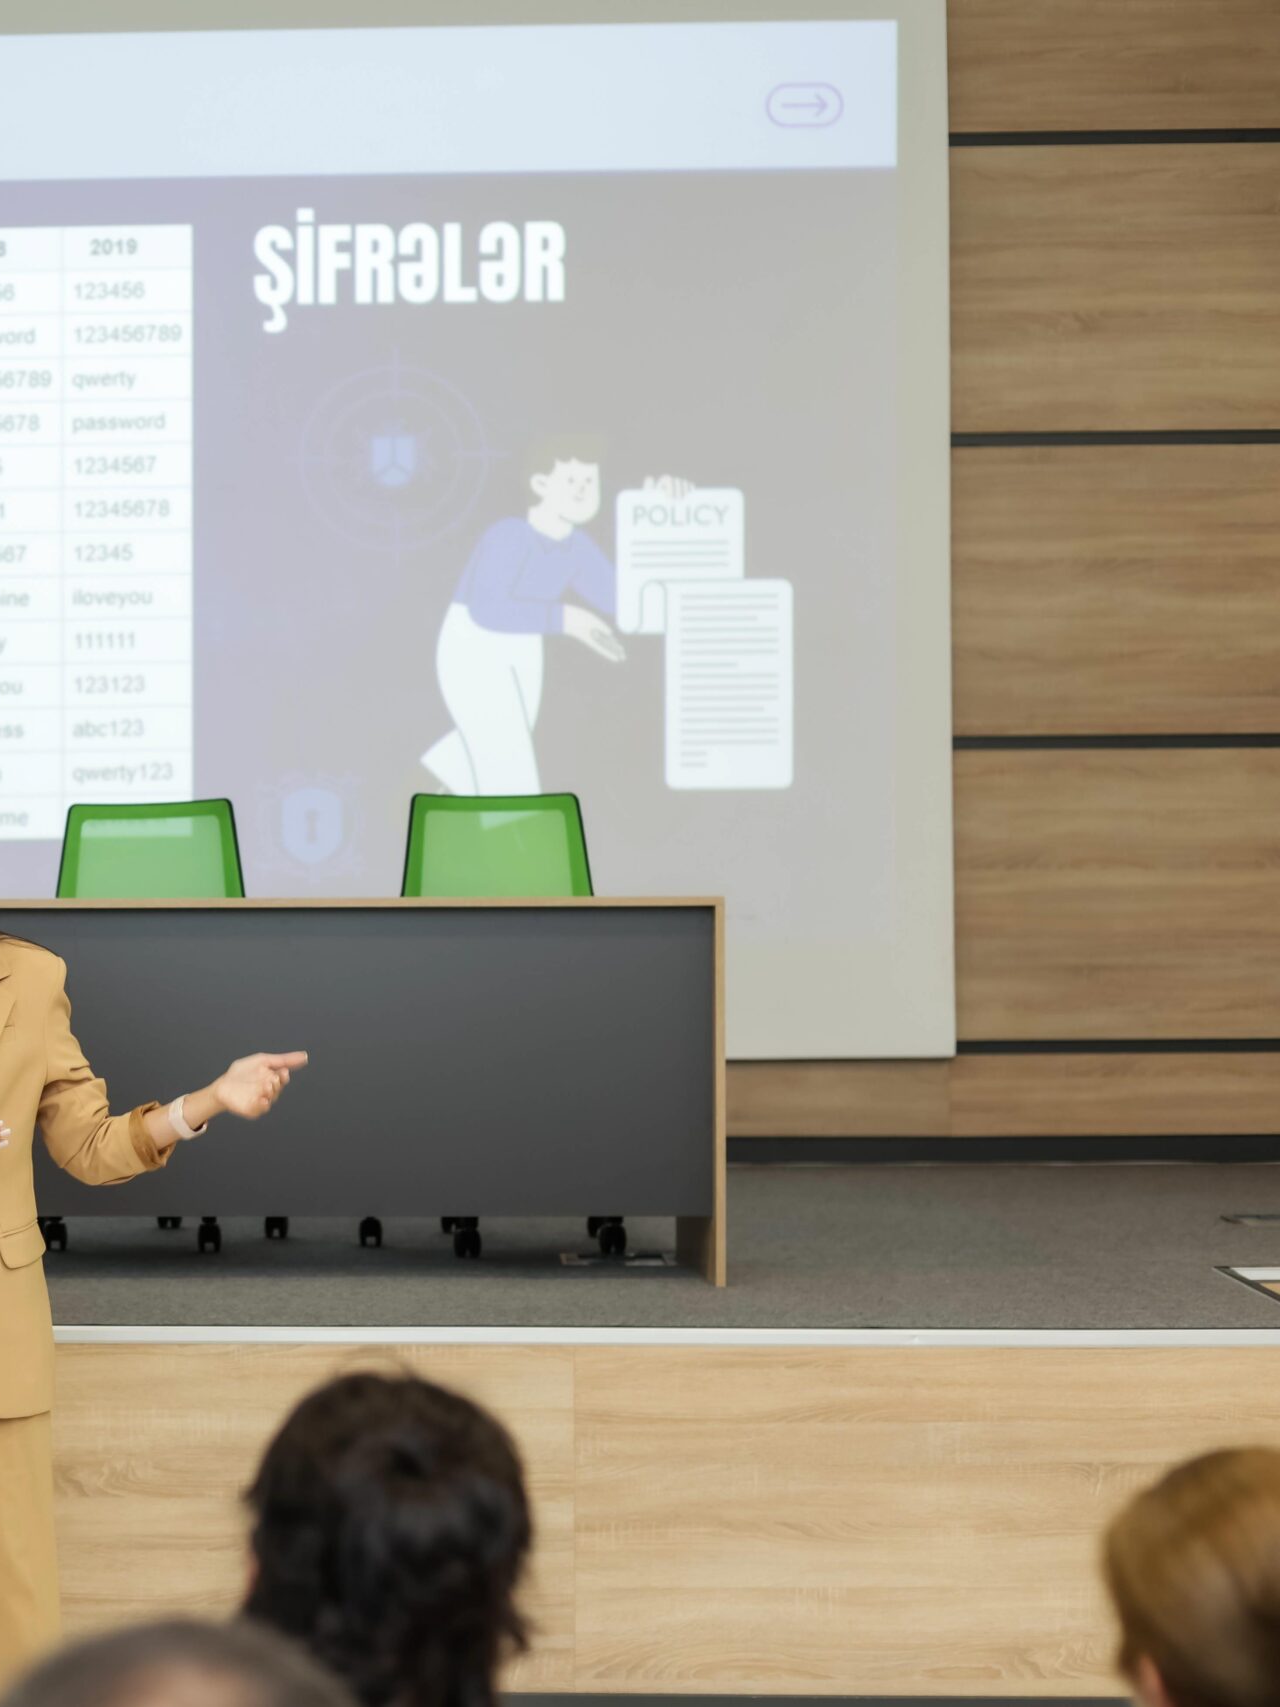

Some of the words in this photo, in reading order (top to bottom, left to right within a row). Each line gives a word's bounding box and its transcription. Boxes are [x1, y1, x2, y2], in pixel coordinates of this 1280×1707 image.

[90, 238, 138, 256] 2019
[253, 207, 566, 333] ŞİFRƏLƏR
[74, 281, 145, 300] 123456
[75, 324, 182, 344] 123456789
[72, 371, 136, 390] qwerty
[72, 413, 166, 434] password
[75, 455, 156, 475] 1234567
[75, 499, 170, 518] 12345678
[632, 504, 730, 526] POLICY
[75, 543, 134, 562] 12345
[72, 589, 153, 608] iloveyou
[75, 632, 135, 649] 111111
[74, 674, 146, 694] 123123
[72, 718, 144, 738] abc123
[72, 762, 173, 784] qwerty123
